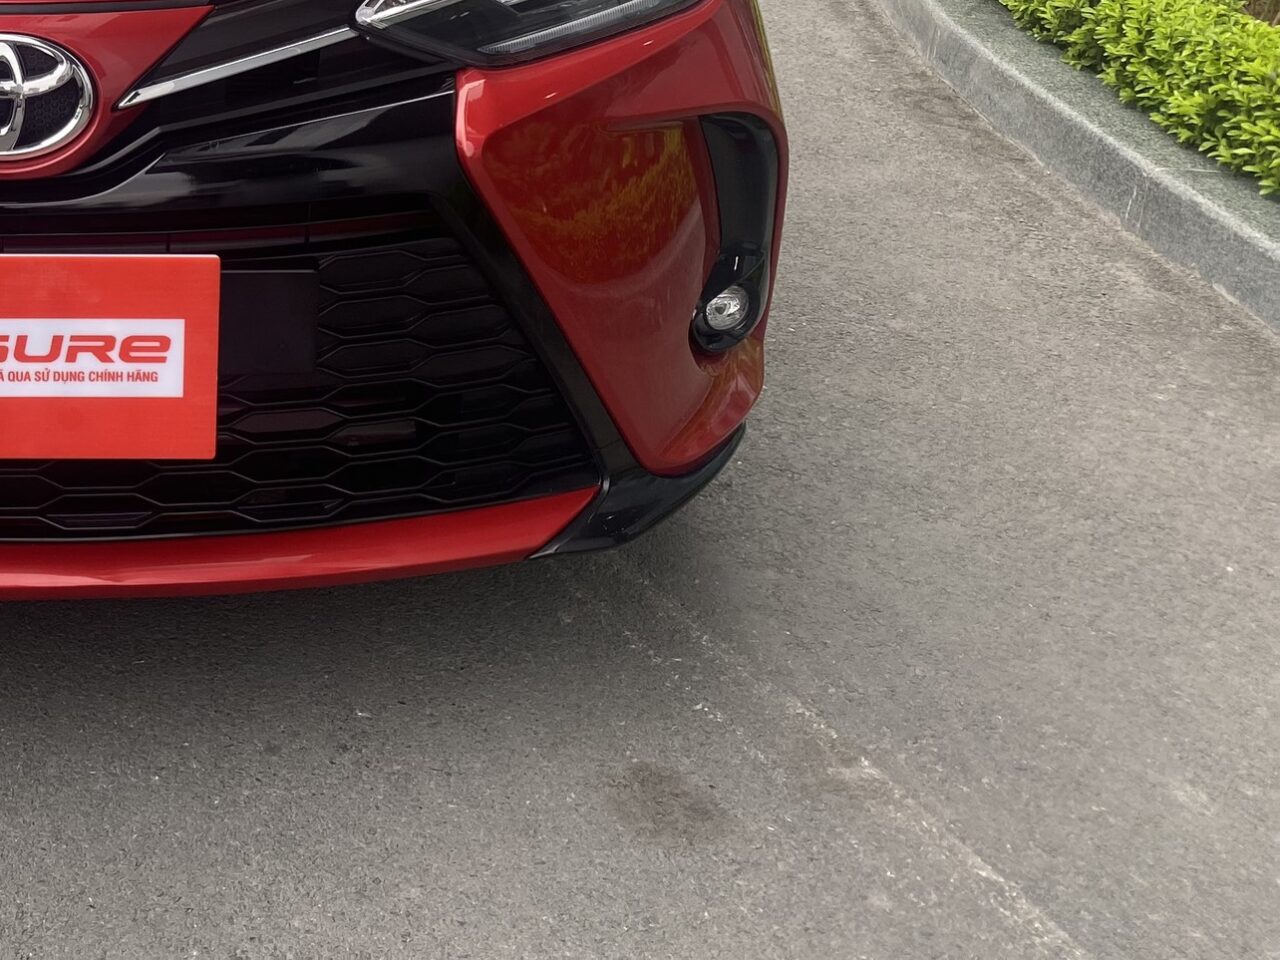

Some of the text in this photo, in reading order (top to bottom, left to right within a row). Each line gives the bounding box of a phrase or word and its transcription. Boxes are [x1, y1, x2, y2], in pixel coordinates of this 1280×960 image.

[8, 370, 31, 382] QUA
[34, 367, 50, 382] SỬ
[53, 370, 85, 384] DỤNG
[88, 368, 123, 382] CHÍNH
[127, 369, 158, 382] HÃNG
